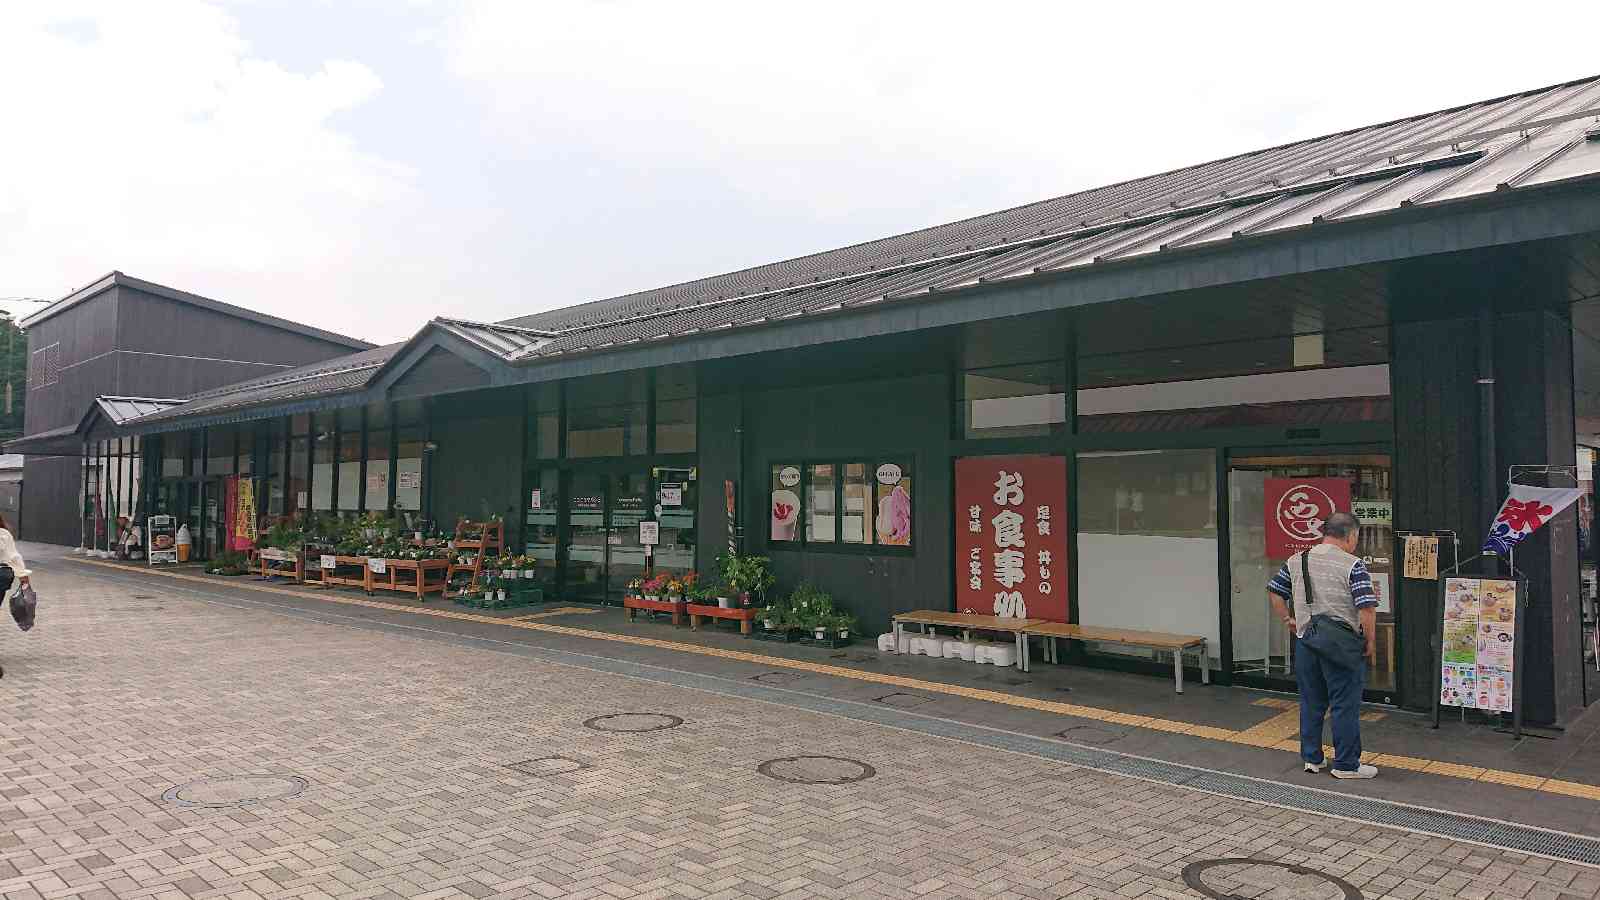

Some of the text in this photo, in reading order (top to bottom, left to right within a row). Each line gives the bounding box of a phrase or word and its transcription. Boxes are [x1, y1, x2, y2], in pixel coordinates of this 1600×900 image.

[1354, 507, 1390, 519] 営業中
[1497, 497, 1553, 534] 氷
